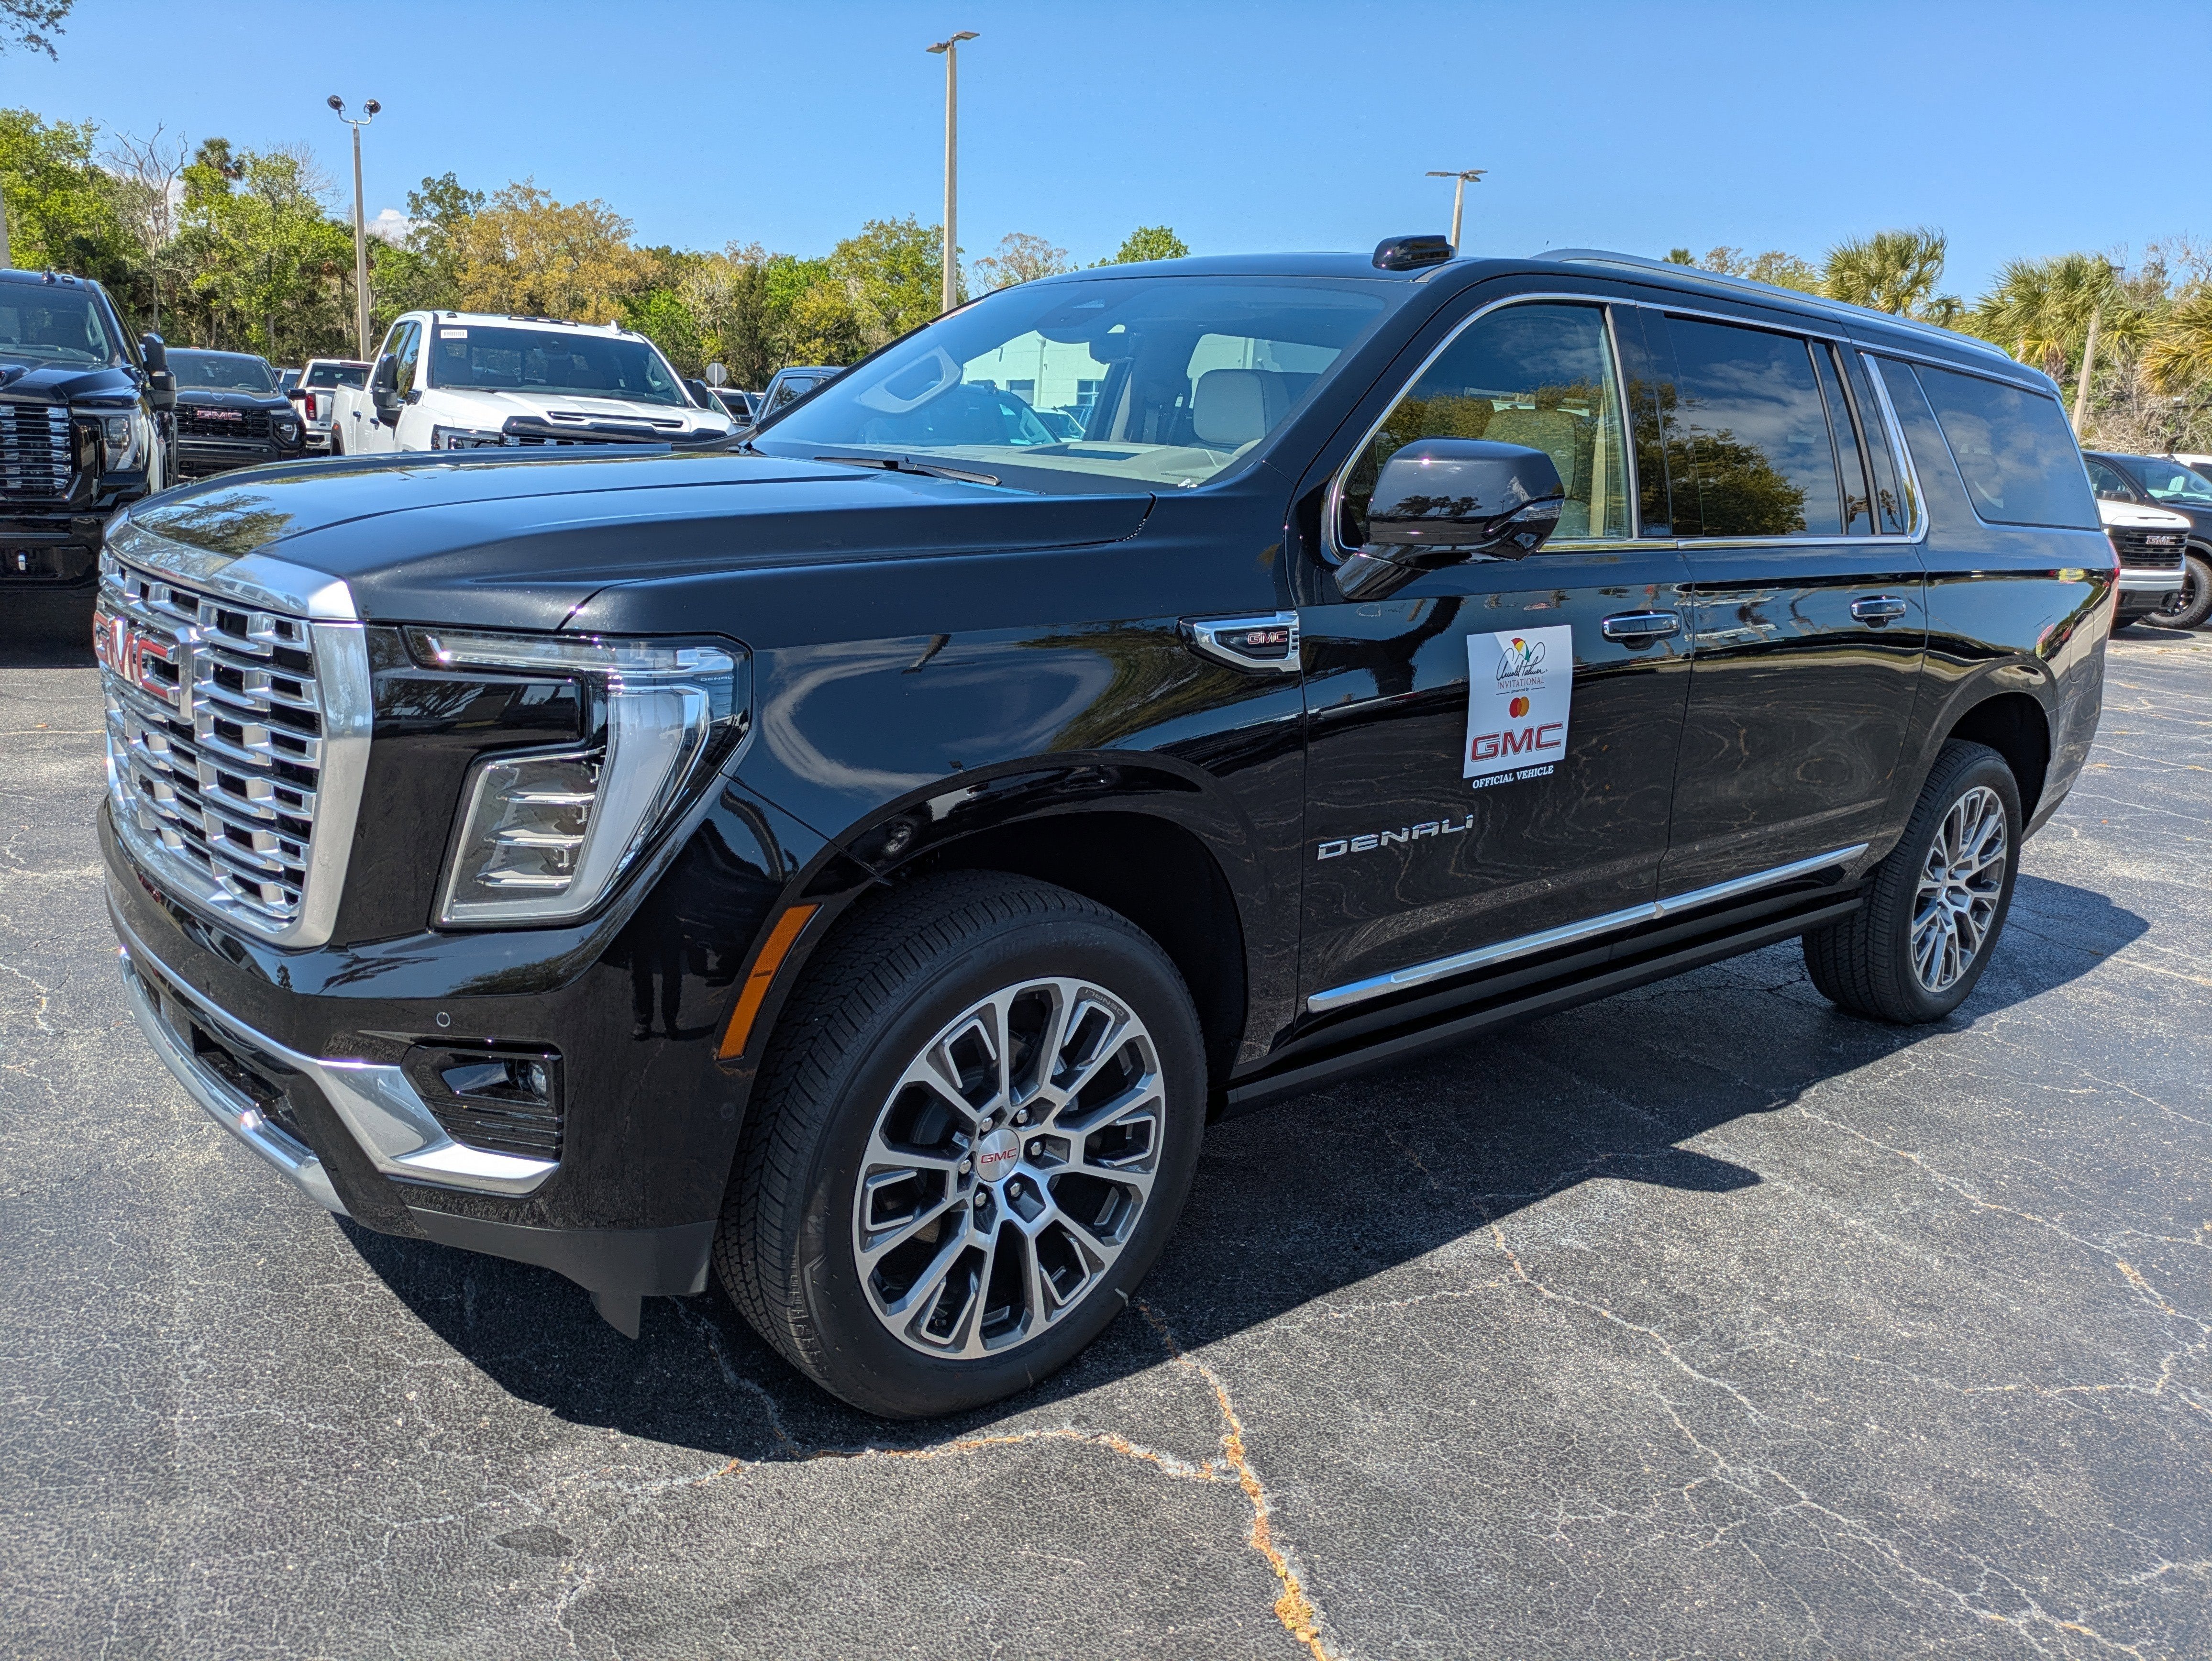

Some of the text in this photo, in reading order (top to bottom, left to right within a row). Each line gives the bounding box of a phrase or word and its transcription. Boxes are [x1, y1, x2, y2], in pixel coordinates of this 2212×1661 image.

[197, 410, 242, 421] GMC
[2146, 535, 2176, 545] GMC
[1248, 631, 1288, 645] GMC
[93, 610, 180, 706] GMC
[1497, 676, 1545, 690] INVITATIONAL
[1470, 720, 1564, 763] GMC
[1472, 765, 1554, 789] OFFICIAL VEHICLE
[1317, 814, 1473, 861] DENALI
[1085, 989, 1124, 1017] DENALI
[981, 1147, 1017, 1164] GMC
